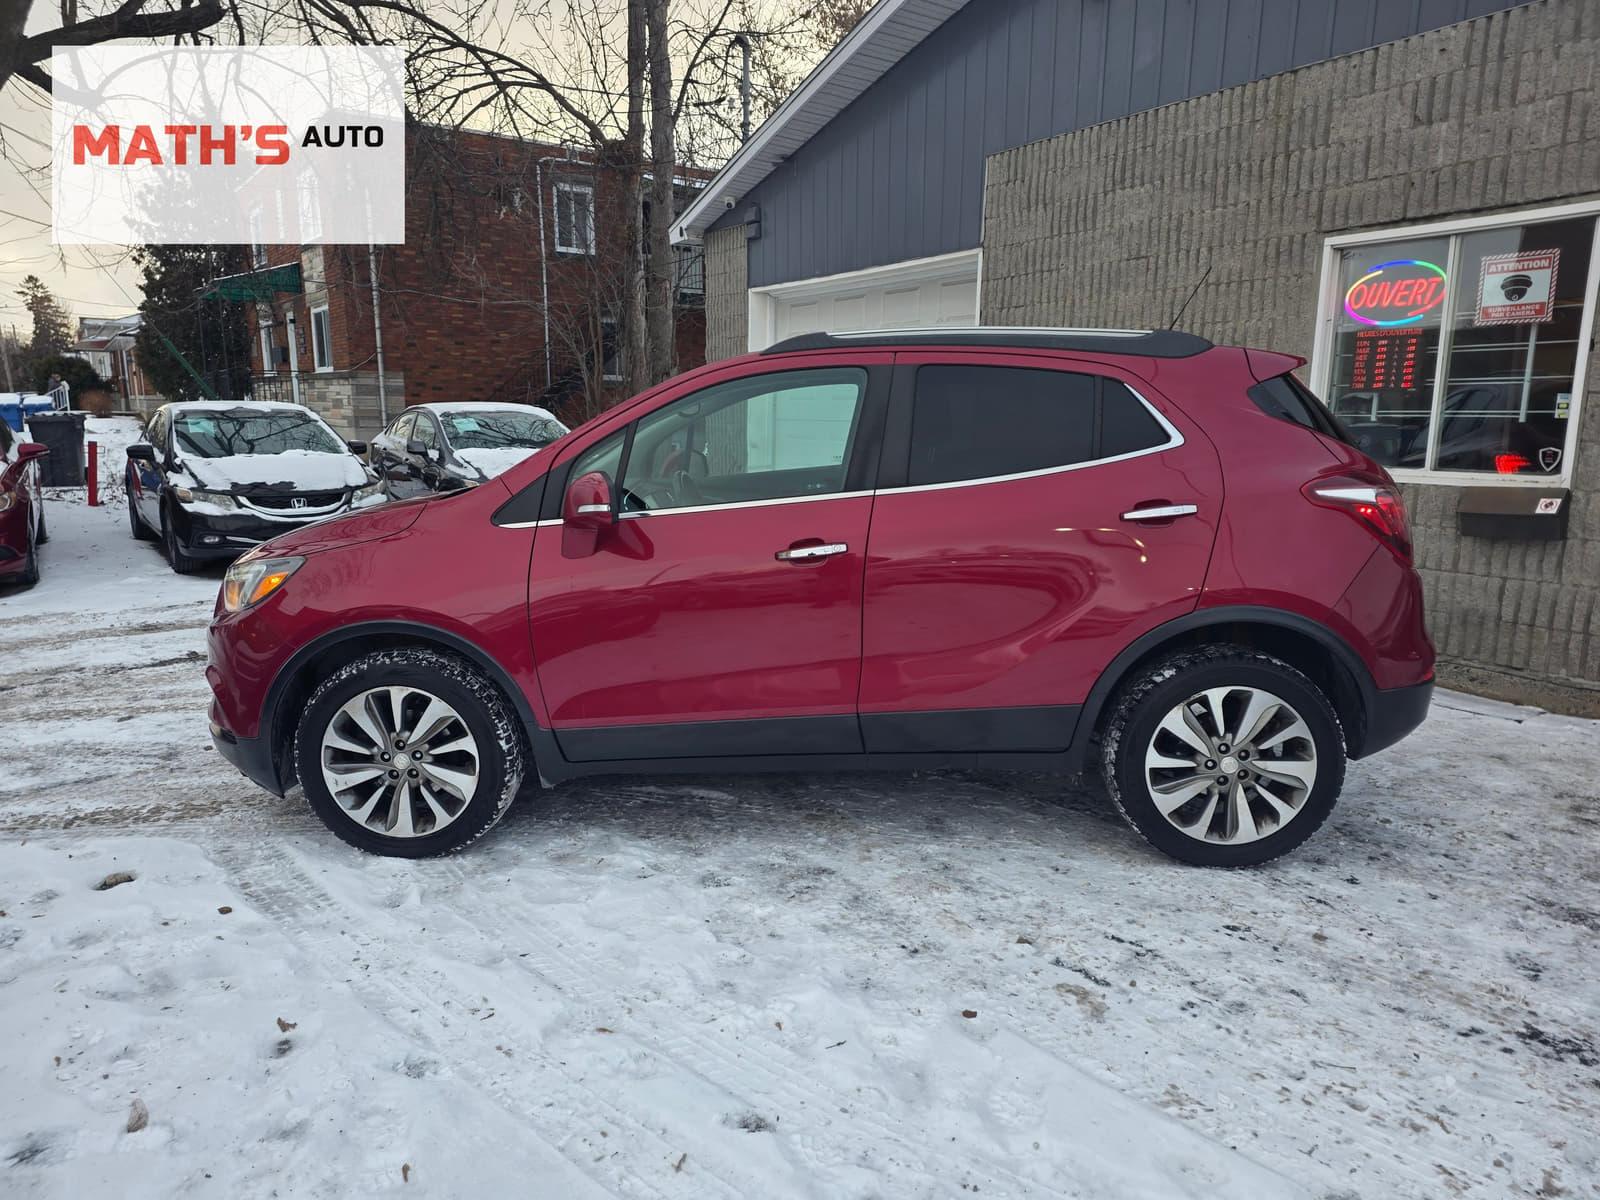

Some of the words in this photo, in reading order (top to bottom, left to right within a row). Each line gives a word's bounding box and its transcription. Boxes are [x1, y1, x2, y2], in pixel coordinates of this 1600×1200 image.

[1488, 259, 1549, 273] ATTENTION
[1350, 276, 1443, 310] OUVERT
[1487, 304, 1541, 313] SURVEILLANCE
